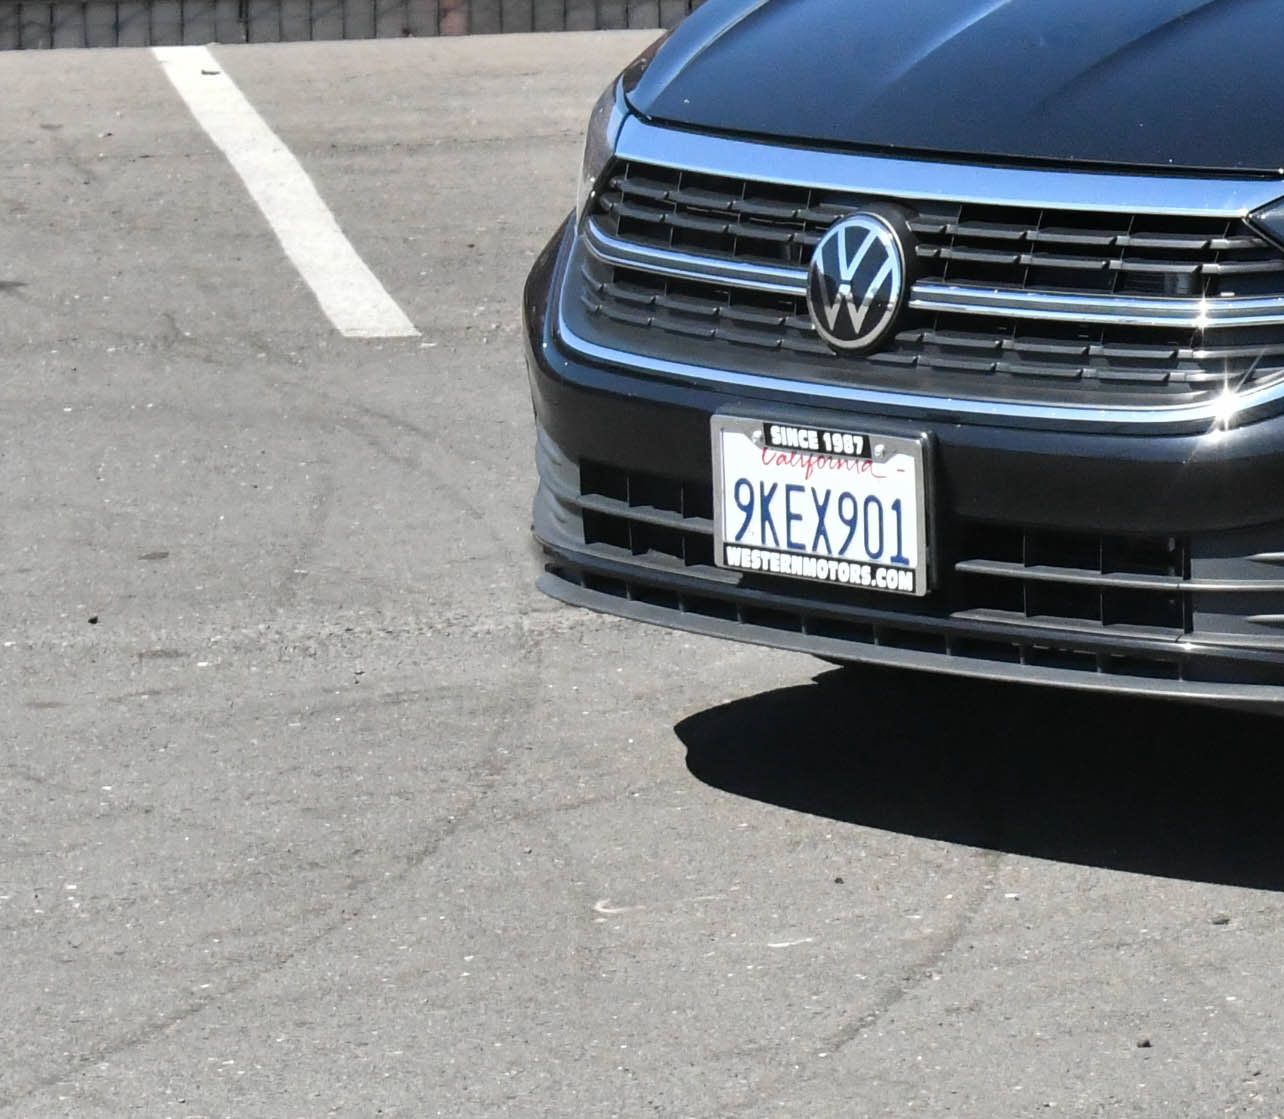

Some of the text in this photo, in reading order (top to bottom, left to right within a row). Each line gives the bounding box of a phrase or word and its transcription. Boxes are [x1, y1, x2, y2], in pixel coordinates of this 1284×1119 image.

[770, 425, 820, 450] SINCE
[733, 477, 909, 566] 9KEX901
[726, 545, 914, 593] WESTERNMOTORS.COM
